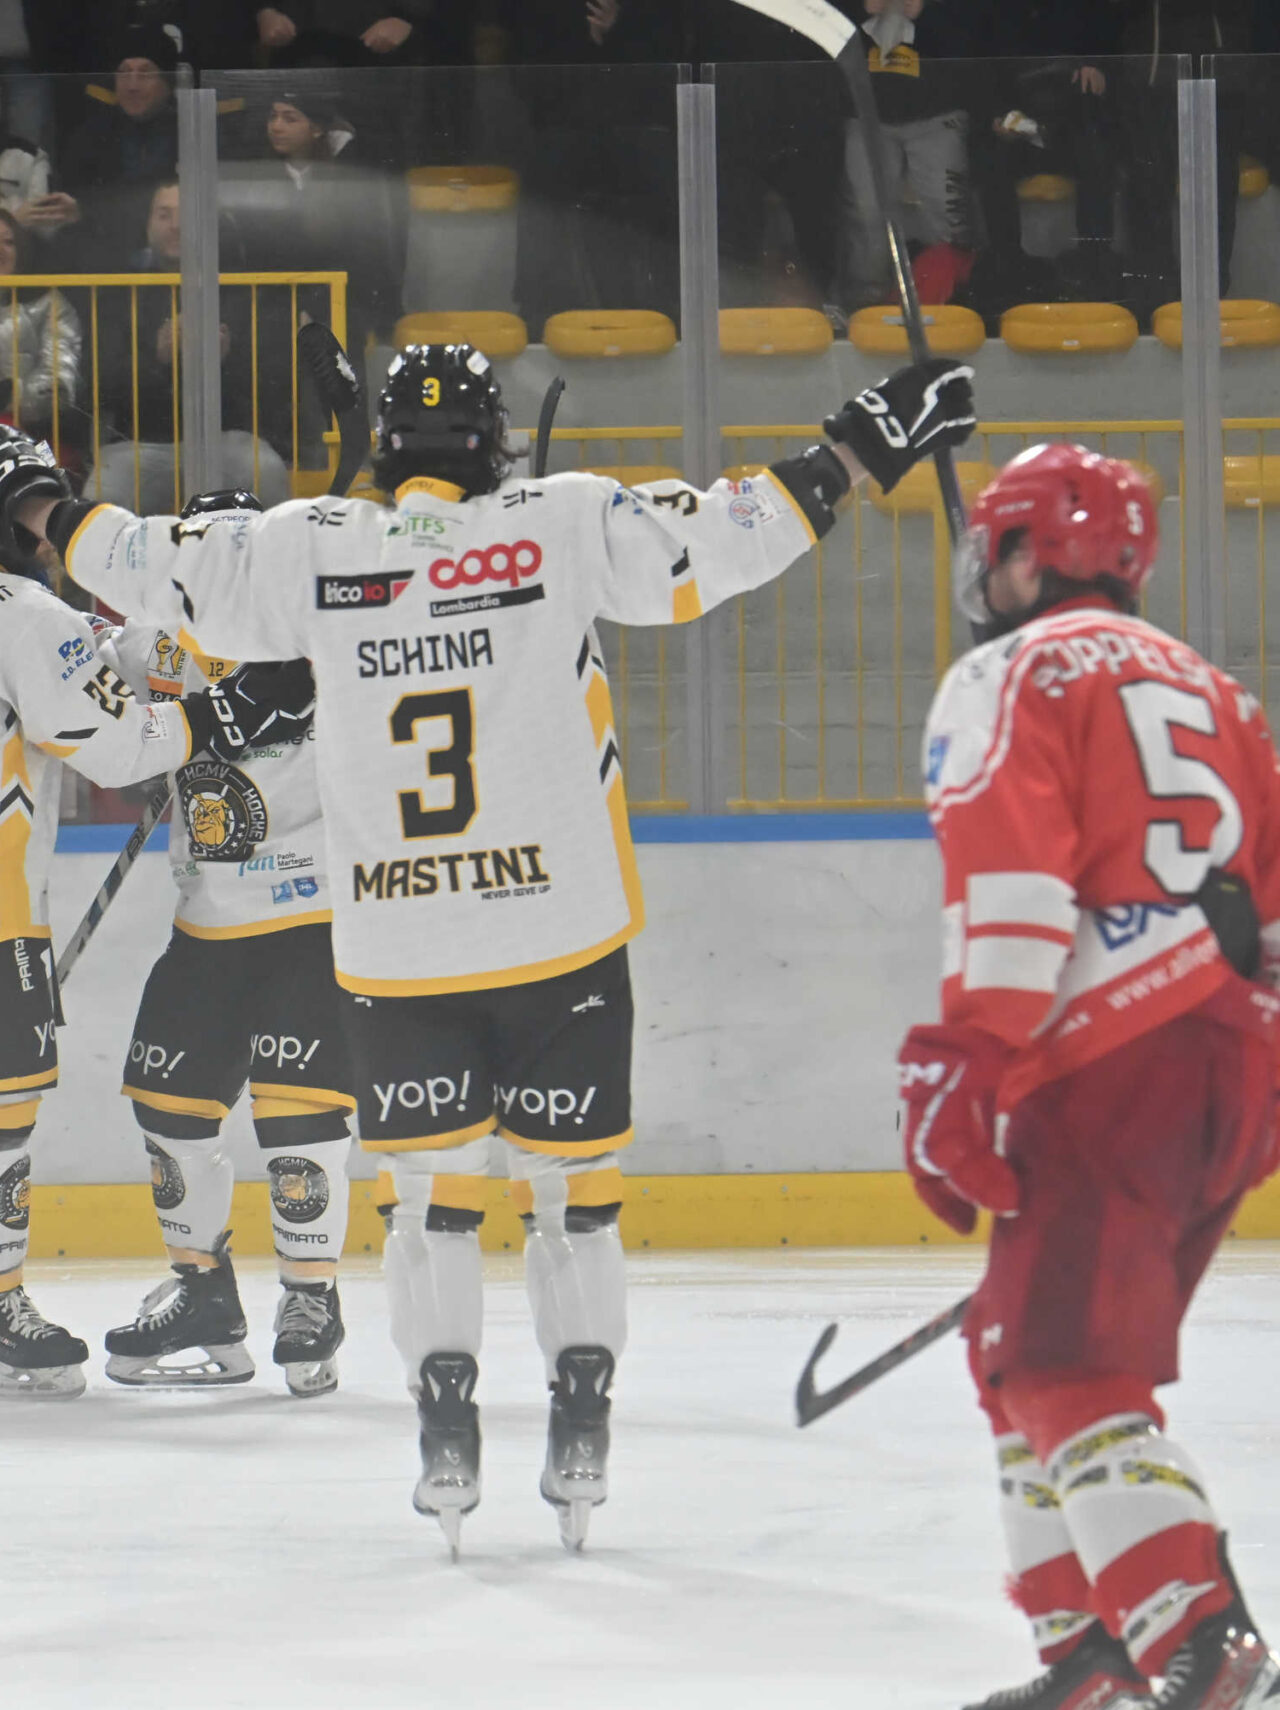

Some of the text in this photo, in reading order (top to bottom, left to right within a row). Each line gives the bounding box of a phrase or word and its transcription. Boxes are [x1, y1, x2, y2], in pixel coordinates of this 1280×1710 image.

[422, 377, 440, 407] 3
[855, 378, 908, 449] CC
[409, 515, 446, 535] TFS
[1126, 501, 1144, 536] 5
[428, 539, 543, 591] coop
[432, 594, 501, 616] Lombardia
[207, 661, 225, 678] 12
[357, 627, 494, 679] SCHINA
[208, 683, 246, 747] CCM
[184, 763, 231, 782] HCMV
[387, 684, 480, 842] 3
[1118, 678, 1244, 895] 5
[241, 787, 267, 842] HOCKE
[352, 843, 552, 903] MASTINI
[481, 888, 512, 901] NEVER
[538, 883, 552, 895] UP
[131, 1038, 185, 1080] op!
[372, 1069, 471, 1122] yop!
[496, 1083, 597, 1126] yop!
[157, 1216, 192, 1235] ATO
